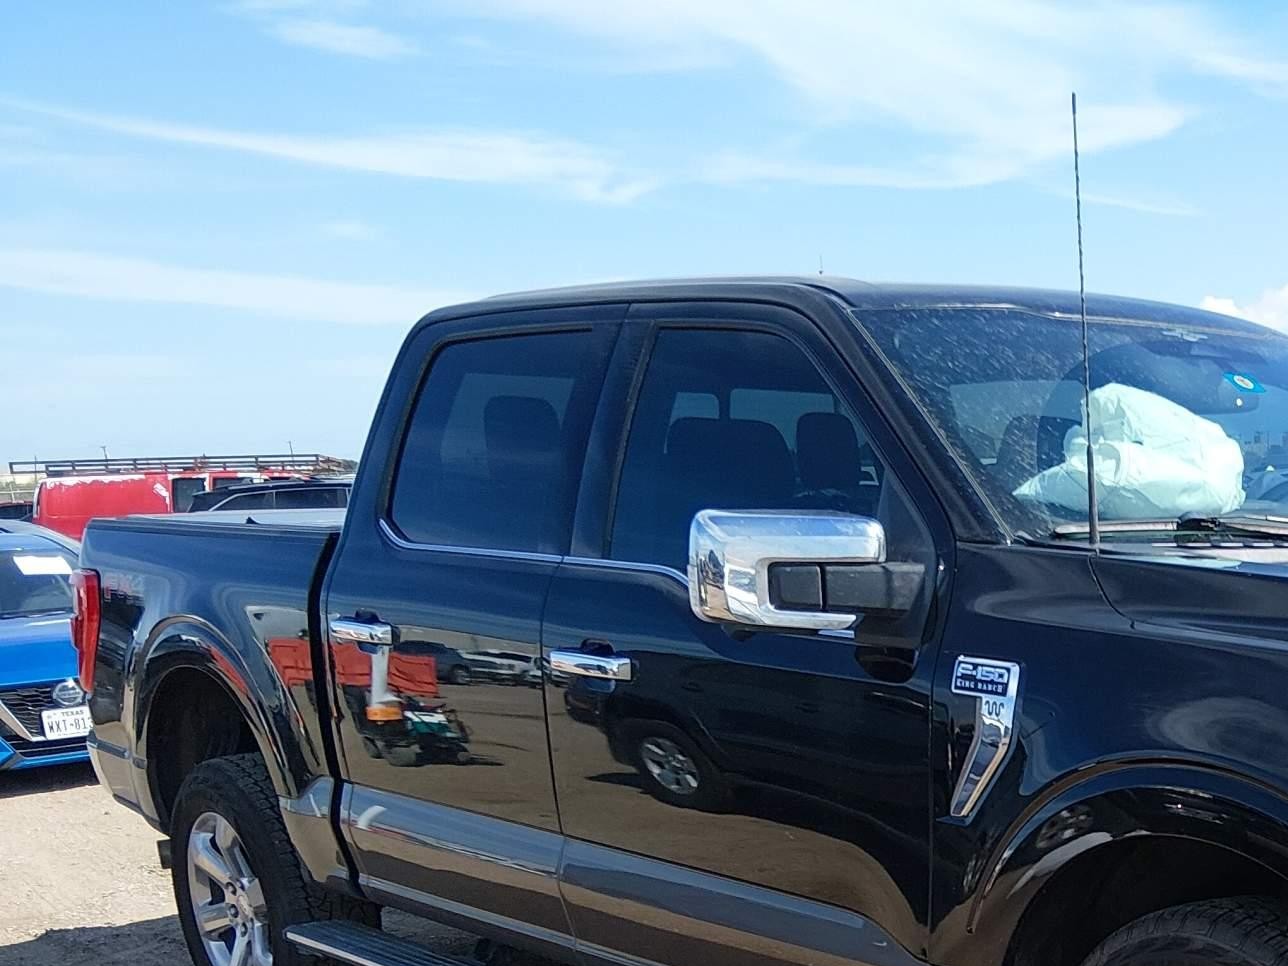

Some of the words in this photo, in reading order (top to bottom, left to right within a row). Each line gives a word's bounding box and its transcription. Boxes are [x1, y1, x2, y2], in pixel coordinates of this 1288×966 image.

[957, 663, 1008, 683] F-150
[956, 679, 975, 689] KING
[977, 682, 1003, 692] RANCH
[61, 709, 84, 717] TEXAS
